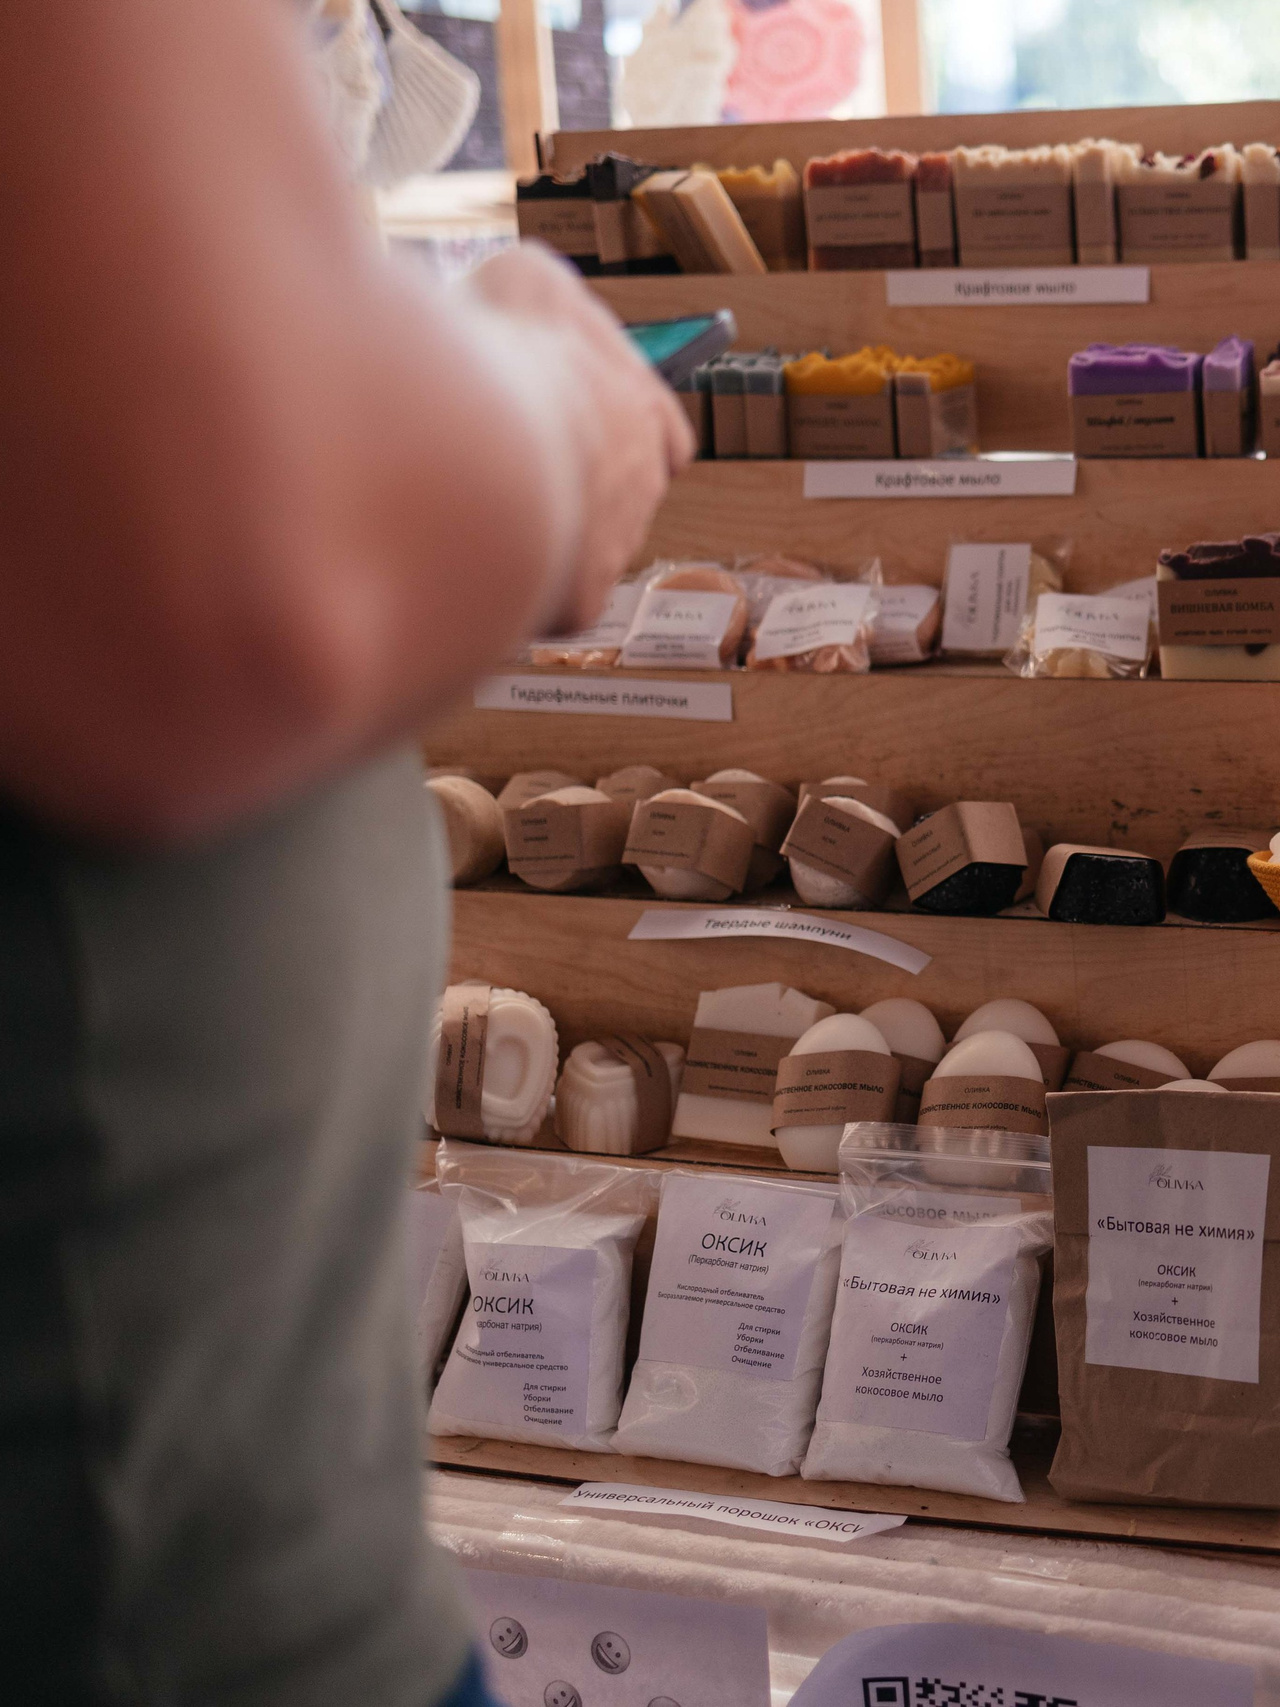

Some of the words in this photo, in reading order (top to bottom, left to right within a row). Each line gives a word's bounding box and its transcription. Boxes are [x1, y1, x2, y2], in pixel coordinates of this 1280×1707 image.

[955, 281, 1031, 297] Крафтовое
[1035, 282, 1077, 294] мыло
[875, 473, 954, 489] Крафтовое
[958, 474, 1001, 486] мыло
[1170, 603, 1232, 614] ВИШНЕВАЯ
[1235, 601, 1275, 612] БОМБА
[510, 684, 618, 706] Гидрофильные
[621, 691, 689, 708] плиточки
[704, 918, 771, 929] Твердые
[774, 920, 852, 941] шампуни
[806, 1068, 831, 1076] ОЛИВКА
[1113, 1073, 1140, 1086] ОЛИВКА
[814, 1083, 858, 1092] КОКОСОВОЕ
[859, 1084, 884, 1094] МЫЛО
[972, 1102, 1020, 1112] КОКОСОВОЕ
[1021, 1105, 1042, 1119] МЫЛО
[1156, 1177, 1204, 1191] OLIVKA
[720, 1210, 767, 1226] OLIVKA
[1097, 1216, 1170, 1235] «Бытовая
[1175, 1223, 1194, 1237] не
[1198, 1225, 1255, 1241] химия»
[701, 1233, 768, 1258] ОКСИК
[912, 1250, 957, 1261] OLIVKA
[688, 1254, 739, 1269] (Перкарбонат
[739, 1263, 770, 1275] натрия)
[1157, 1264, 1196, 1277] ОКСИК
[484, 1271, 530, 1283] OLIVKA
[676, 1282, 719, 1295] Кислородный
[720, 1288, 765, 1301] отбеливатель
[843, 1275, 915, 1297] «Бытовая
[918, 1287, 937, 1298] не
[939, 1288, 1001, 1304] химия»
[1138, 1278, 1185, 1290] (перкарбонат
[1186, 1283, 1213, 1293] натрия)
[473, 1295, 534, 1315] ОКСИК
[657, 1291, 704, 1303] Биоразлагаемое
[704, 1296, 754, 1310] универсальное
[754, 1304, 786, 1315] средство
[1171, 1297, 1179, 1306] +
[1133, 1310, 1216, 1329] Хозяйственное
[511, 1321, 542, 1333] натрия)
[738, 1322, 753, 1332] Для
[754, 1326, 781, 1336] стирки
[890, 1322, 929, 1336] ОКСИК
[736, 1333, 764, 1345] Уборки
[871, 1334, 916, 1347] (перкарбонат
[917, 1340, 944, 1350] натрия)
[1129, 1329, 1187, 1343] кокосовое
[1189, 1335, 1219, 1347] мыло
[496, 1350, 545, 1360] отбеливатель
[733, 1344, 785, 1360] Отбеливание
[900, 1353, 908, 1362] +
[482, 1358, 535, 1370] универсальное
[535, 1363, 569, 1372] средство
[731, 1355, 772, 1369] Очищение
[861, 1366, 942, 1385] Хозяйственное
[523, 1383, 538, 1391] Для
[539, 1385, 567, 1393] стирки
[855, 1385, 909, 1399] кокосовое
[911, 1391, 944, 1403] мыло
[523, 1393, 551, 1403] Уборки
[523, 1405, 574, 1415] Отбеливание
[524, 1415, 563, 1427] Очищение
[573, 1488, 715, 1511] Универсальный
[717, 1504, 800, 1527] порошок
